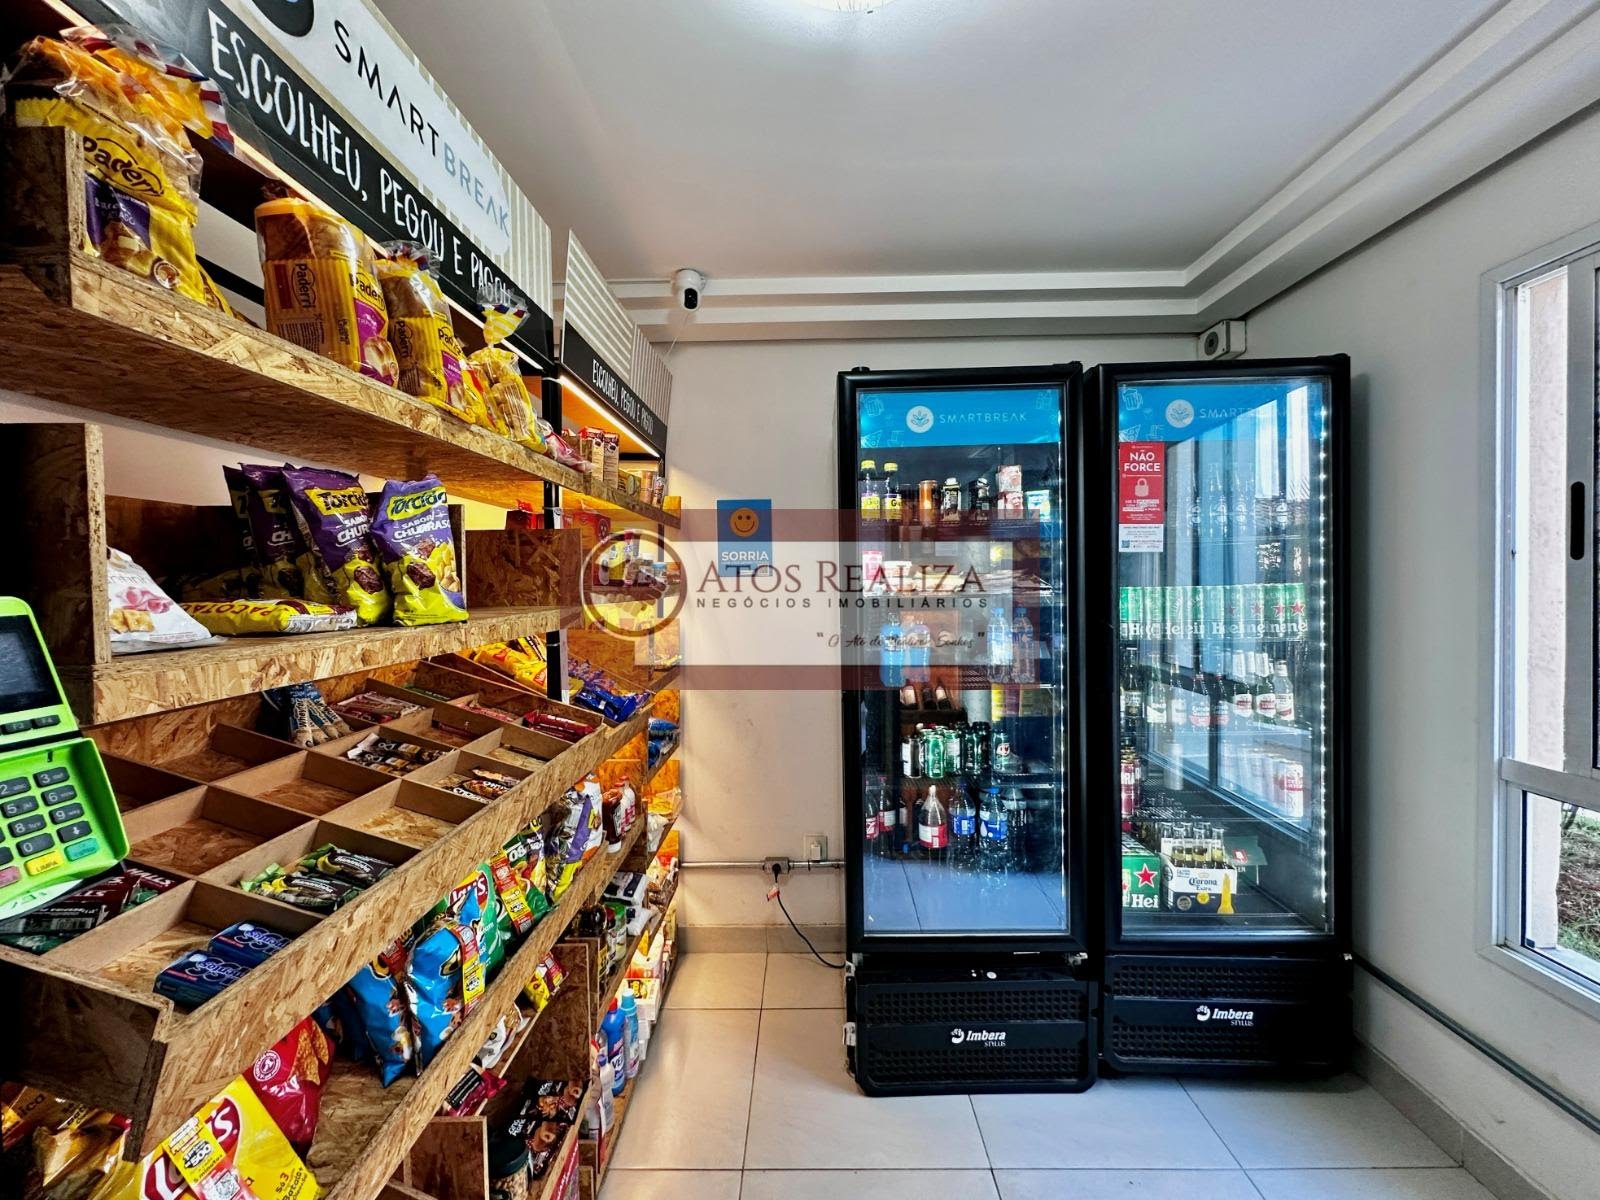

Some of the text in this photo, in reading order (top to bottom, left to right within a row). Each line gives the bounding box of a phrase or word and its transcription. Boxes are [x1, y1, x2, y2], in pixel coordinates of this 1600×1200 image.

[334, 20, 509, 238] SMARTBREAK
[208, 8, 368, 202] ESCOLHEU,
[380, 167, 444, 262] PEGOU
[453, 236, 463, 275] E
[939, 412, 1026, 424] SMARTBREAK
[1129, 449, 1155, 461] NÃO
[1123, 462, 1161, 472] FORCE
[721, 551, 769, 561] SORRIA
[0, 784, 9, 795] 2
[40, 774, 50, 784] 3
[7, 803, 17, 813] 5
[48, 792, 58, 802] 6
[15, 823, 25, 833] 8
[56, 810, 65, 820] 9
[126, 868, 175, 887] HALLS
[1188, 876, 1218, 887] Corona
[1211, 1008, 1254, 1020] Imbera
[966, 1029, 1006, 1042] Imbera
